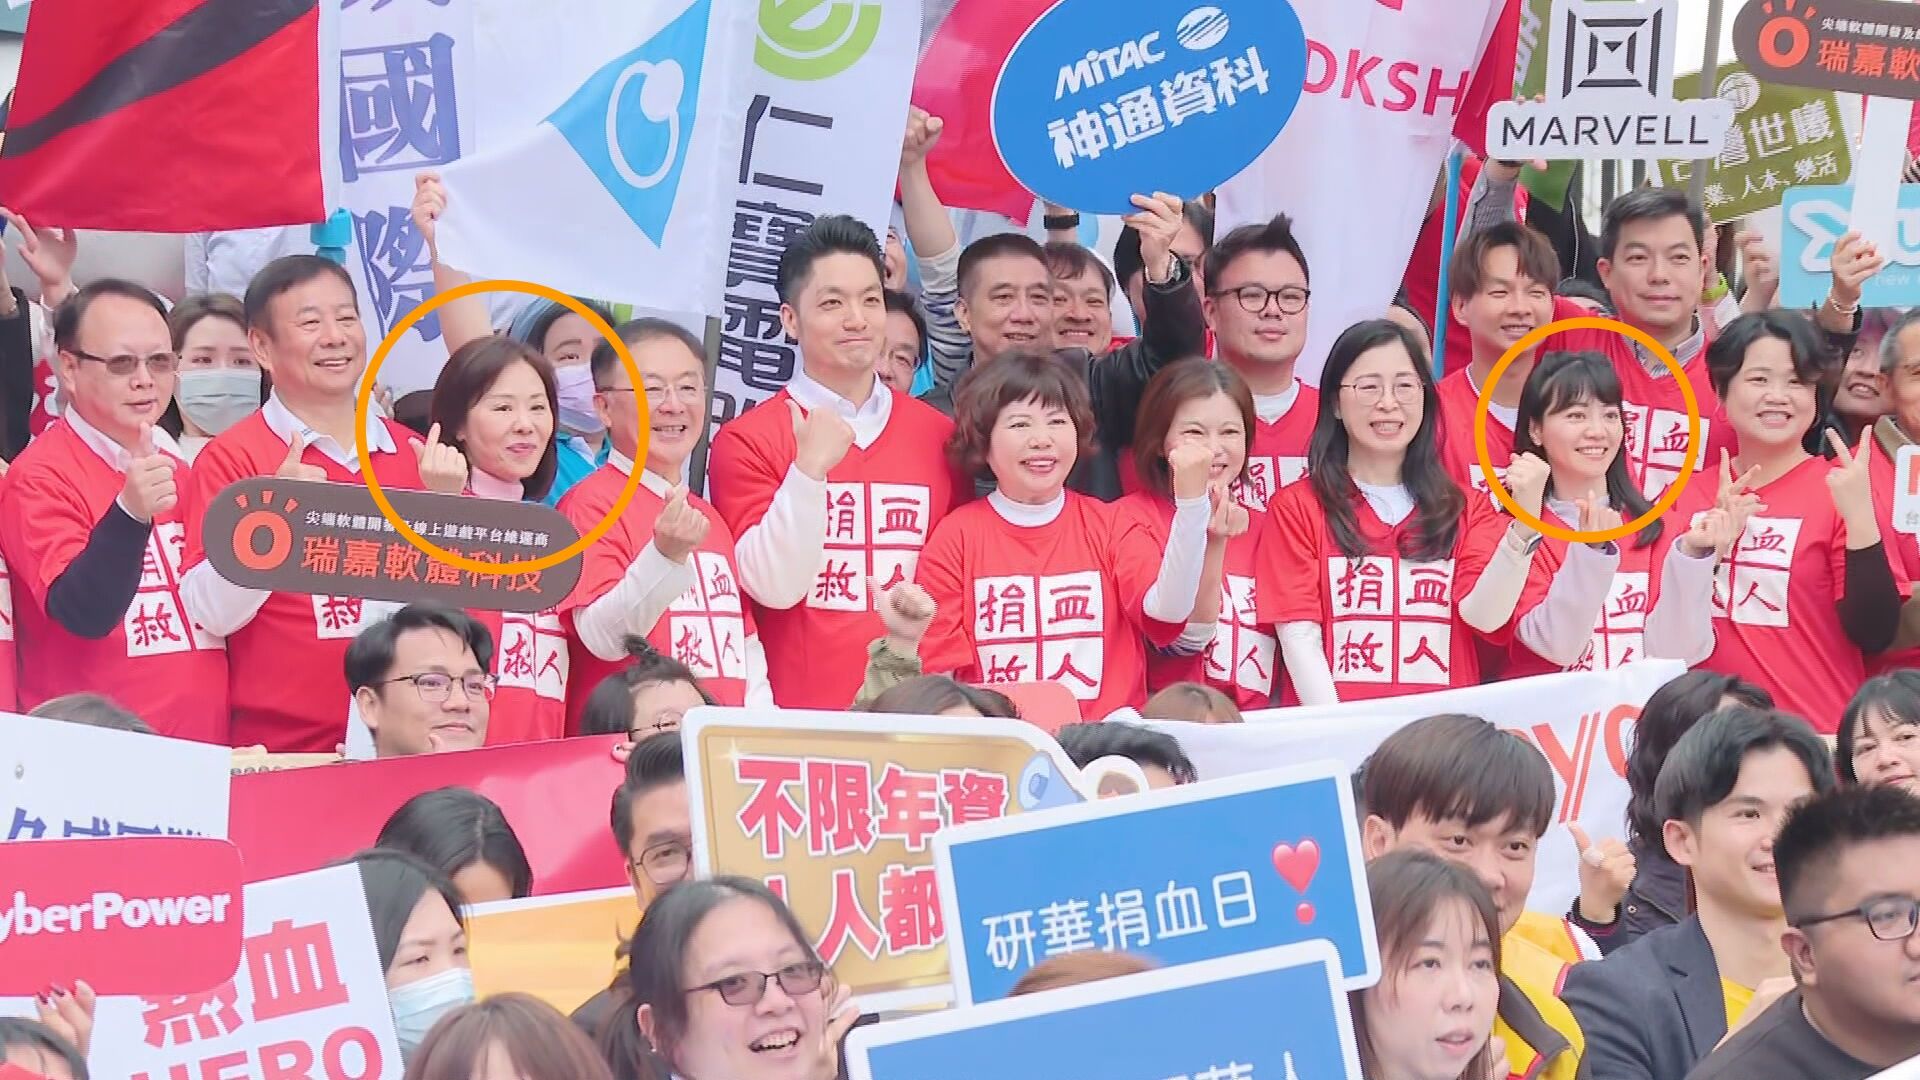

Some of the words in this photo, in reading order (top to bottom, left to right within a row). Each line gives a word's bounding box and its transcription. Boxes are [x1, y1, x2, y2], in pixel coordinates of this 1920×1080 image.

[1047, 46, 1269, 170] 神通資科
[1303, 38, 1471, 116] DKSH
[1501, 115, 1709, 146] MARVELL
[338, 0, 461, 342] 國際
[826, 490, 923, 540] 捐血
[979, 582, 1096, 634] 捐血
[1336, 561, 1450, 611] 捐血
[1337, 628, 1449, 675] 救人
[736, 757, 1008, 857] 不限年資
[981, 869, 1258, 971] 研華捐血日
